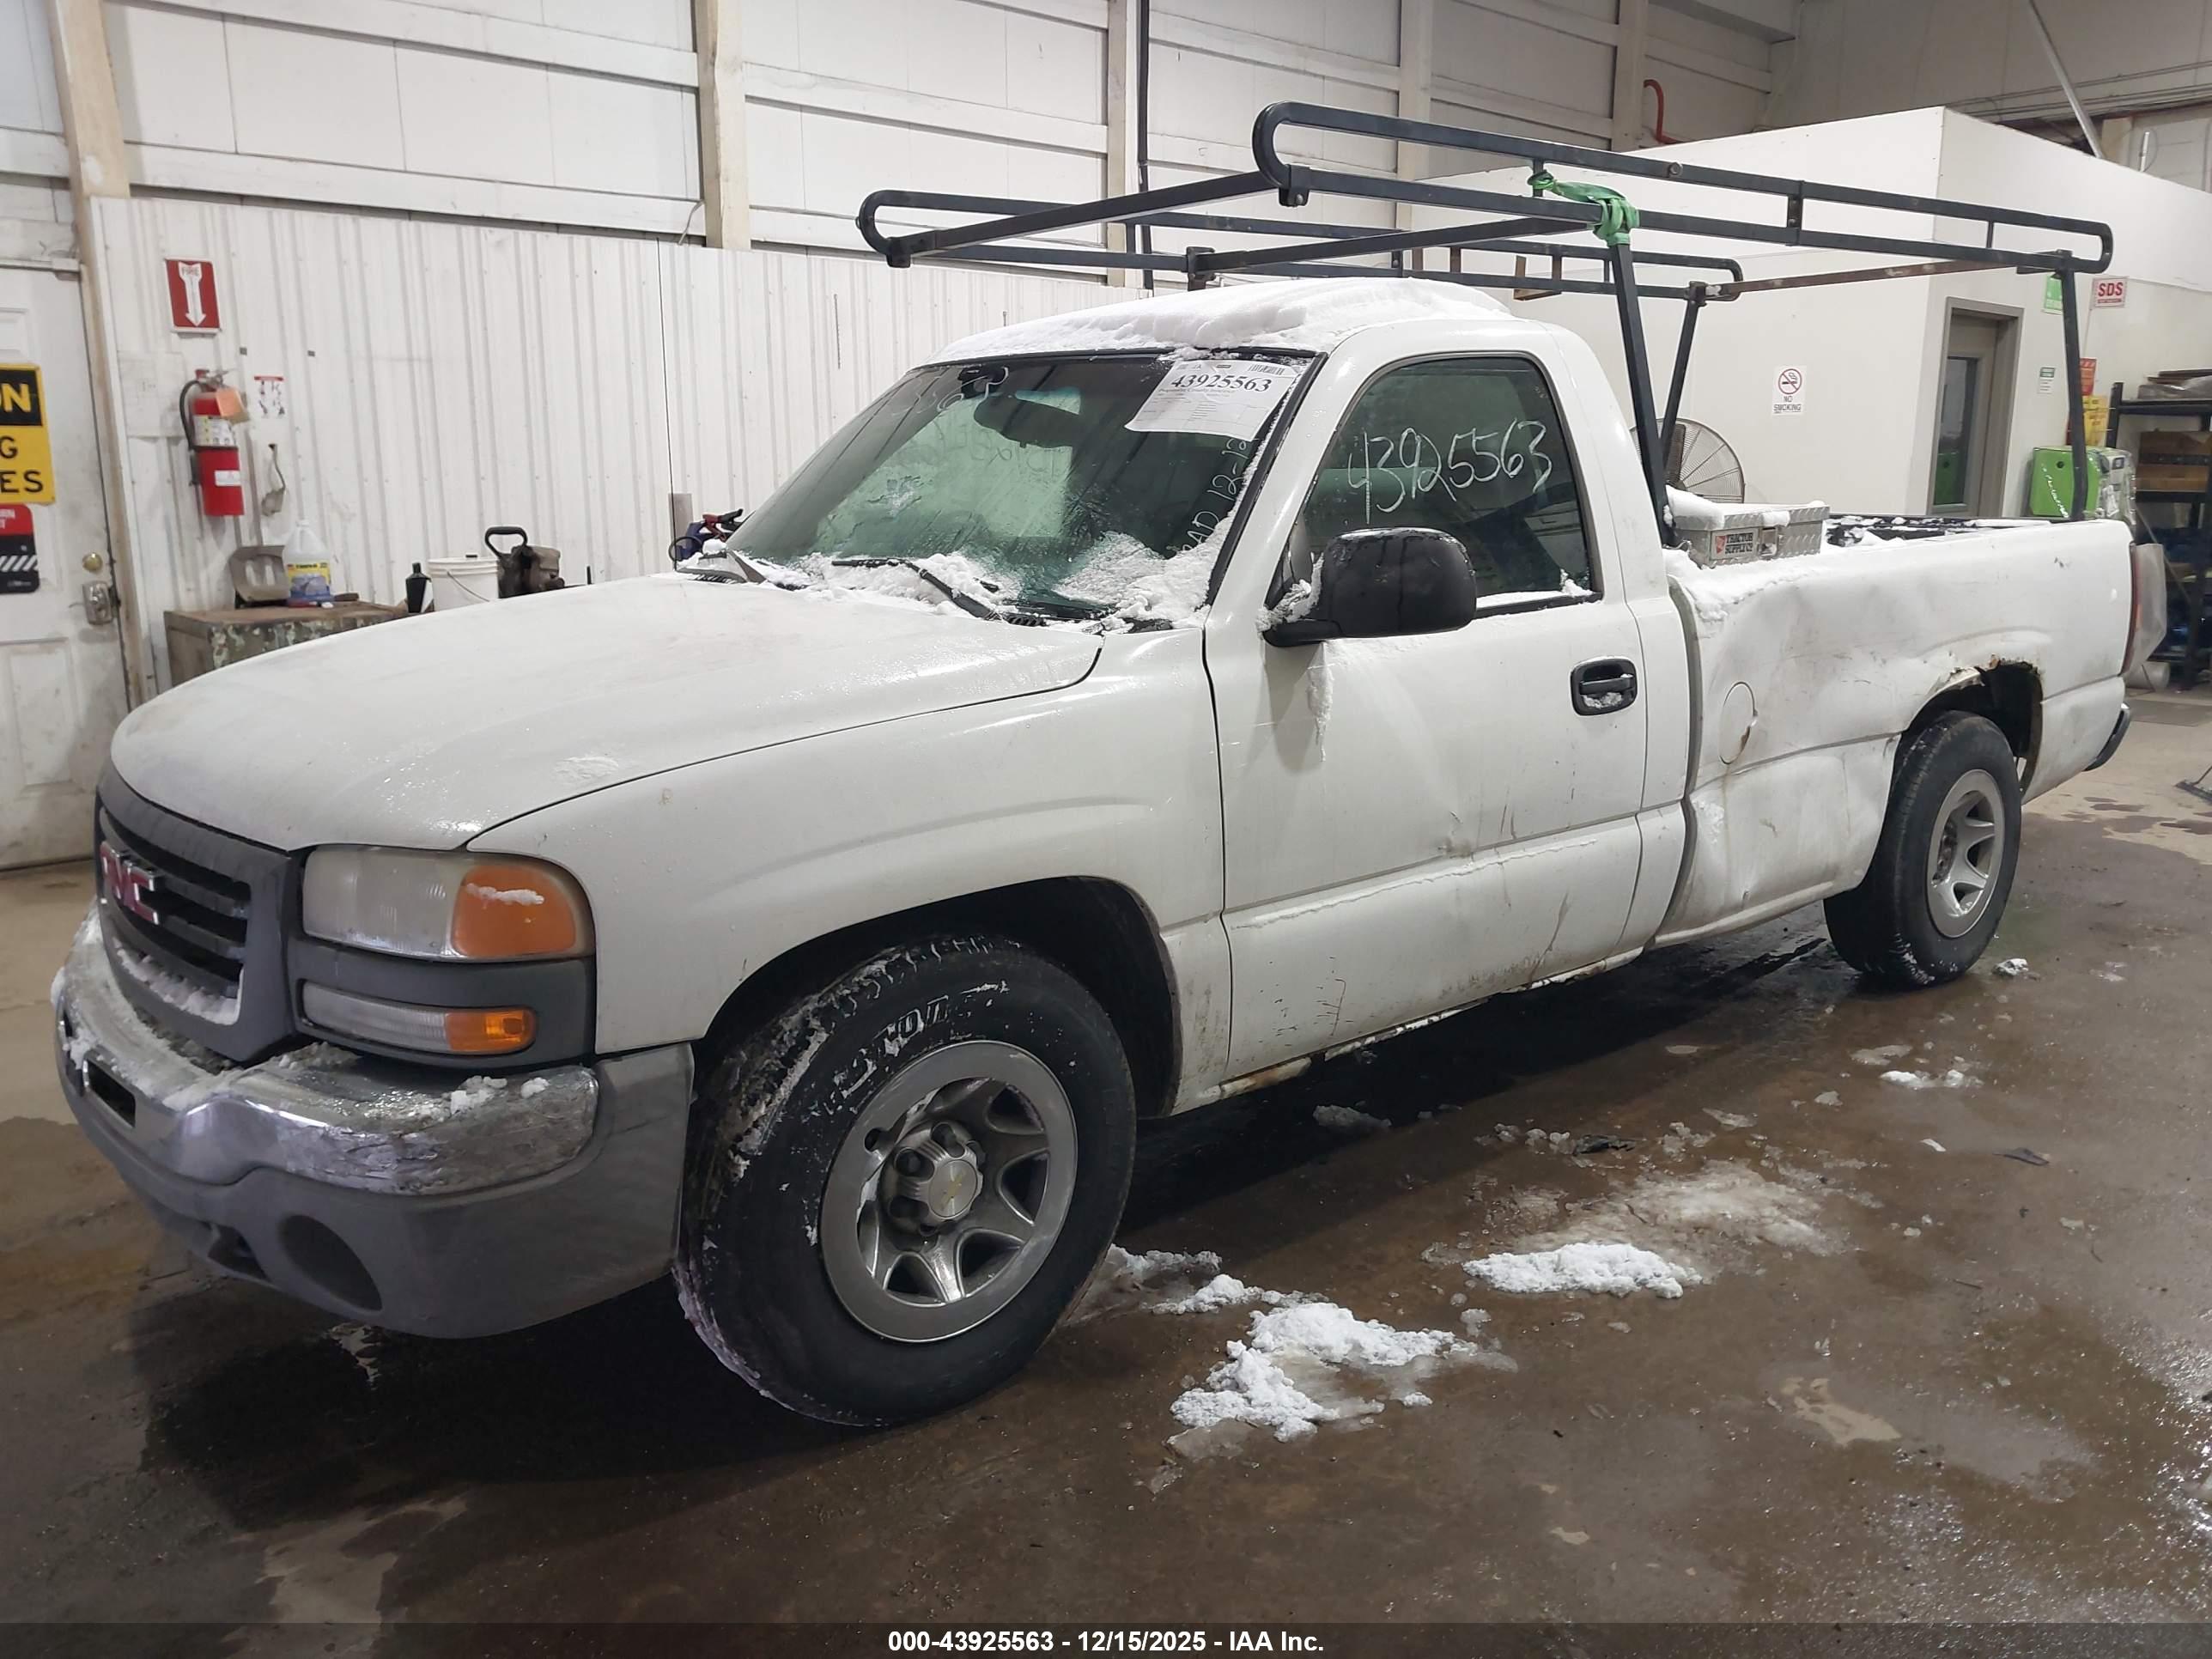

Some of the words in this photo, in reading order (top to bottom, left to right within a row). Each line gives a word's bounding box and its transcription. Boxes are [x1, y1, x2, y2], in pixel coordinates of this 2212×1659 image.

[2098, 282, 2124, 297] SDS
[0, 383, 32, 413] N
[1170, 374, 1273, 392] 43925563
[1347, 417, 1553, 526] 43925563
[100, 842, 160, 925] MC
